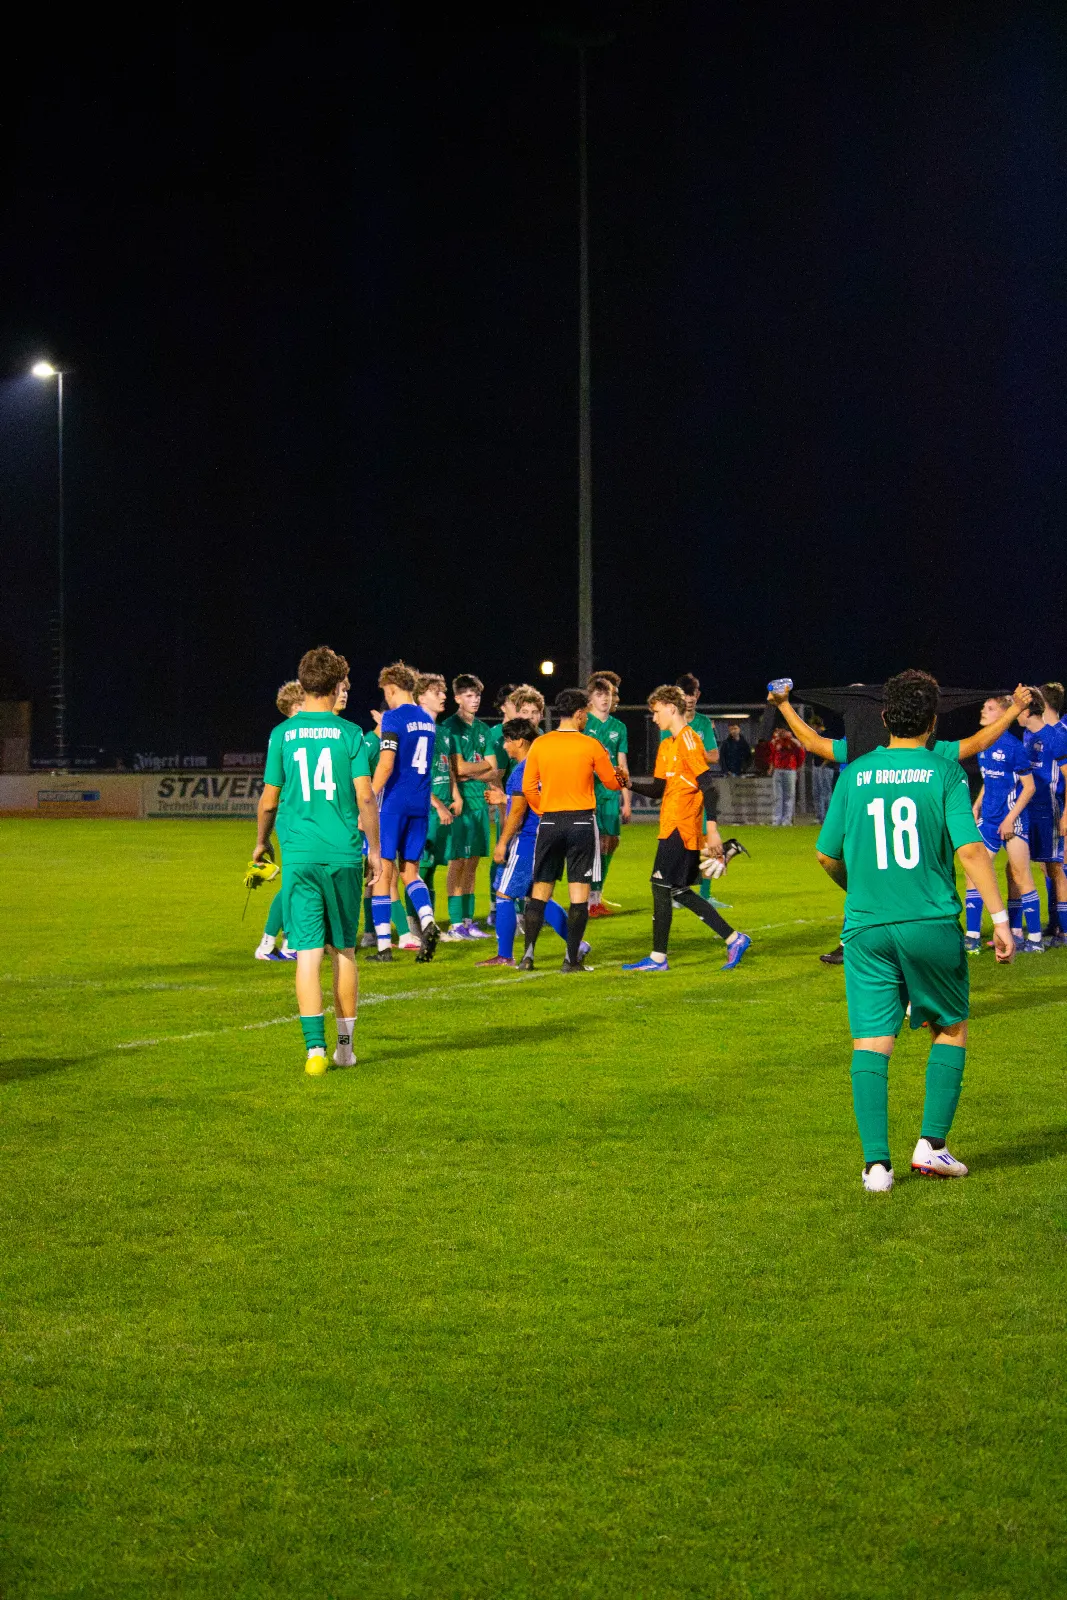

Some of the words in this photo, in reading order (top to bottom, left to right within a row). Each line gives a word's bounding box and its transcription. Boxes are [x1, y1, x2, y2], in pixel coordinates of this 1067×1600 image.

[284, 728, 297, 742] GW
[293, 747, 337, 802] 14
[411, 736, 429, 775] 4
[856, 770, 873, 787] GW
[875, 768, 935, 785] BROCKDORF
[867, 796, 920, 870] 18
